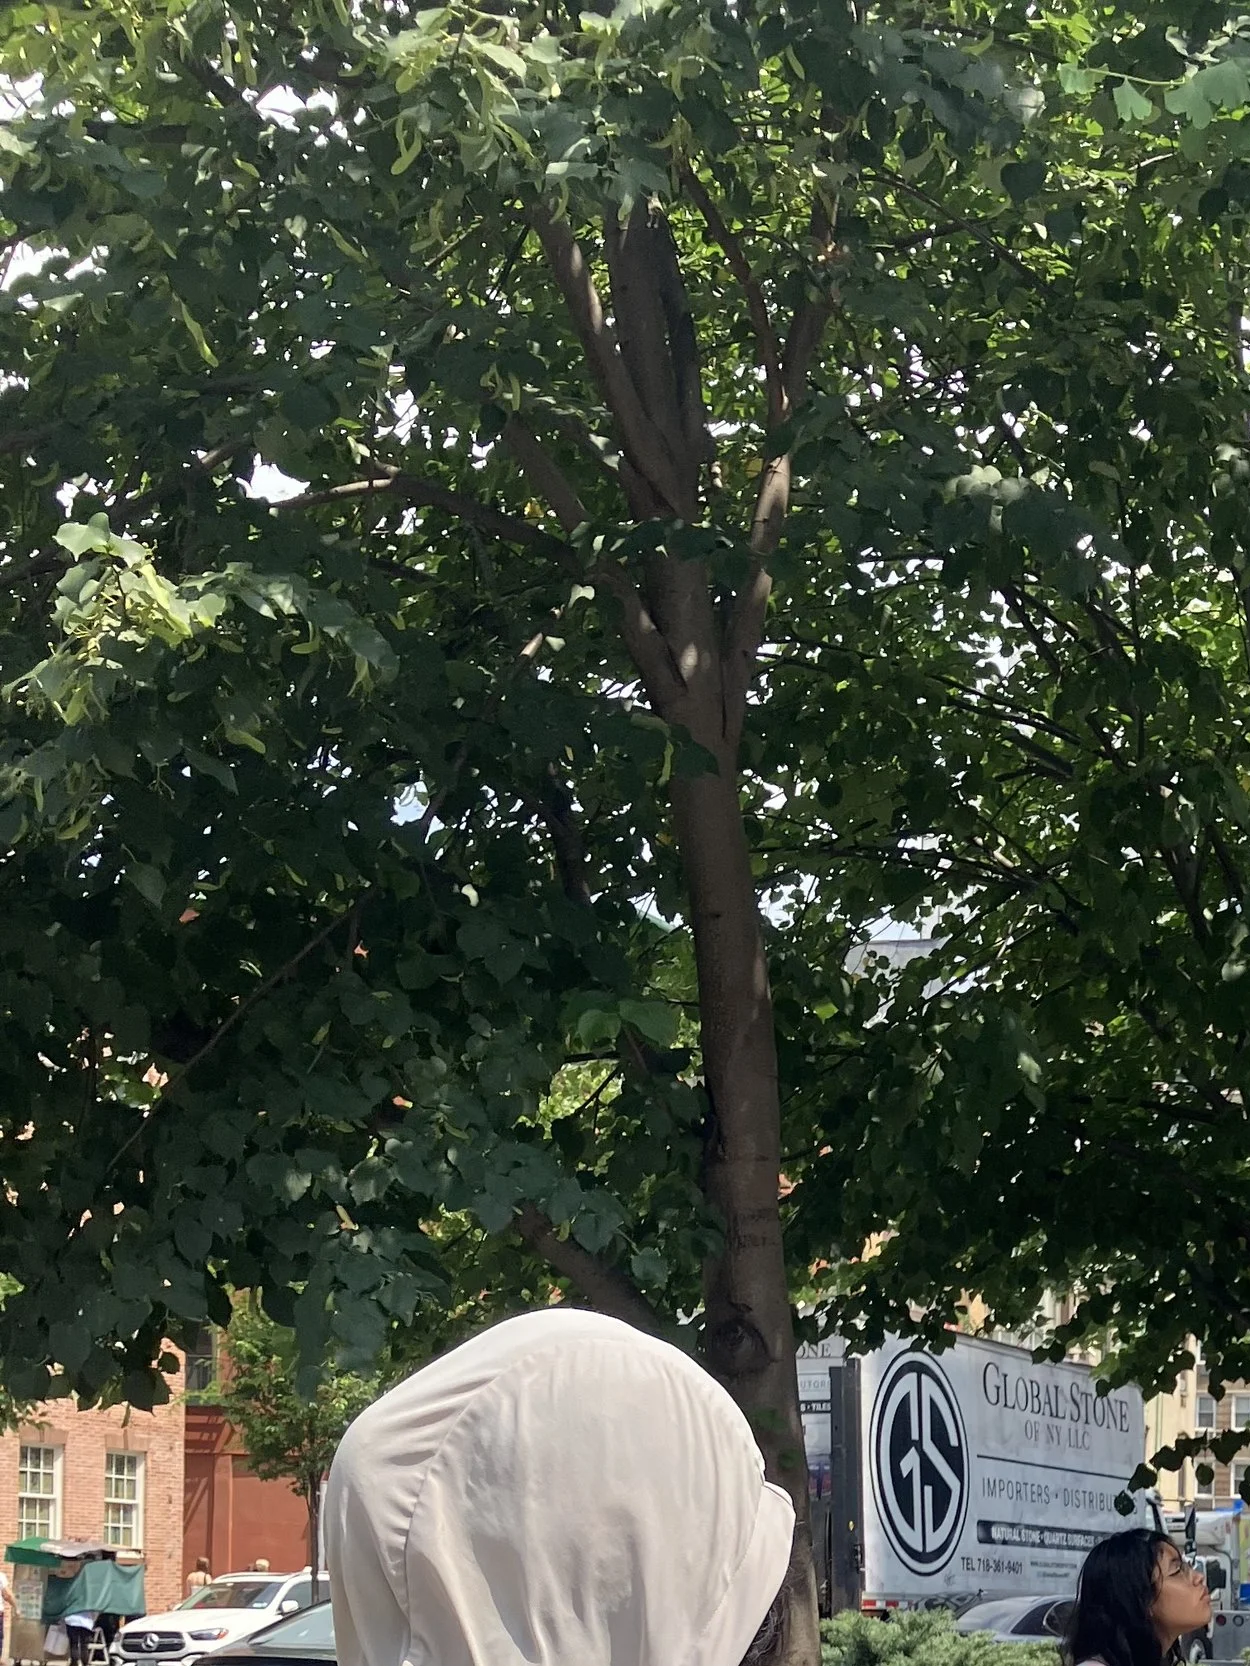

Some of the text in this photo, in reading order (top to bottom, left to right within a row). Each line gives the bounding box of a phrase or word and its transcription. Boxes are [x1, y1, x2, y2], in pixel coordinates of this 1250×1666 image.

[1025, 1420, 1091, 1450] OF NY LLC
[982, 1478, 1138, 1515] IMPORTERS DISTRIBUS
[991, 1525, 1020, 1541] NATURAL
[1021, 1528, 1040, 1543] STONE
[1044, 1530, 1066, 1545] QUARTZ
[1068, 1533, 1095, 1547] SURFACES
[961, 1557, 975, 1571] TEL
[978, 1558, 1023, 1575] 718-361-9401
